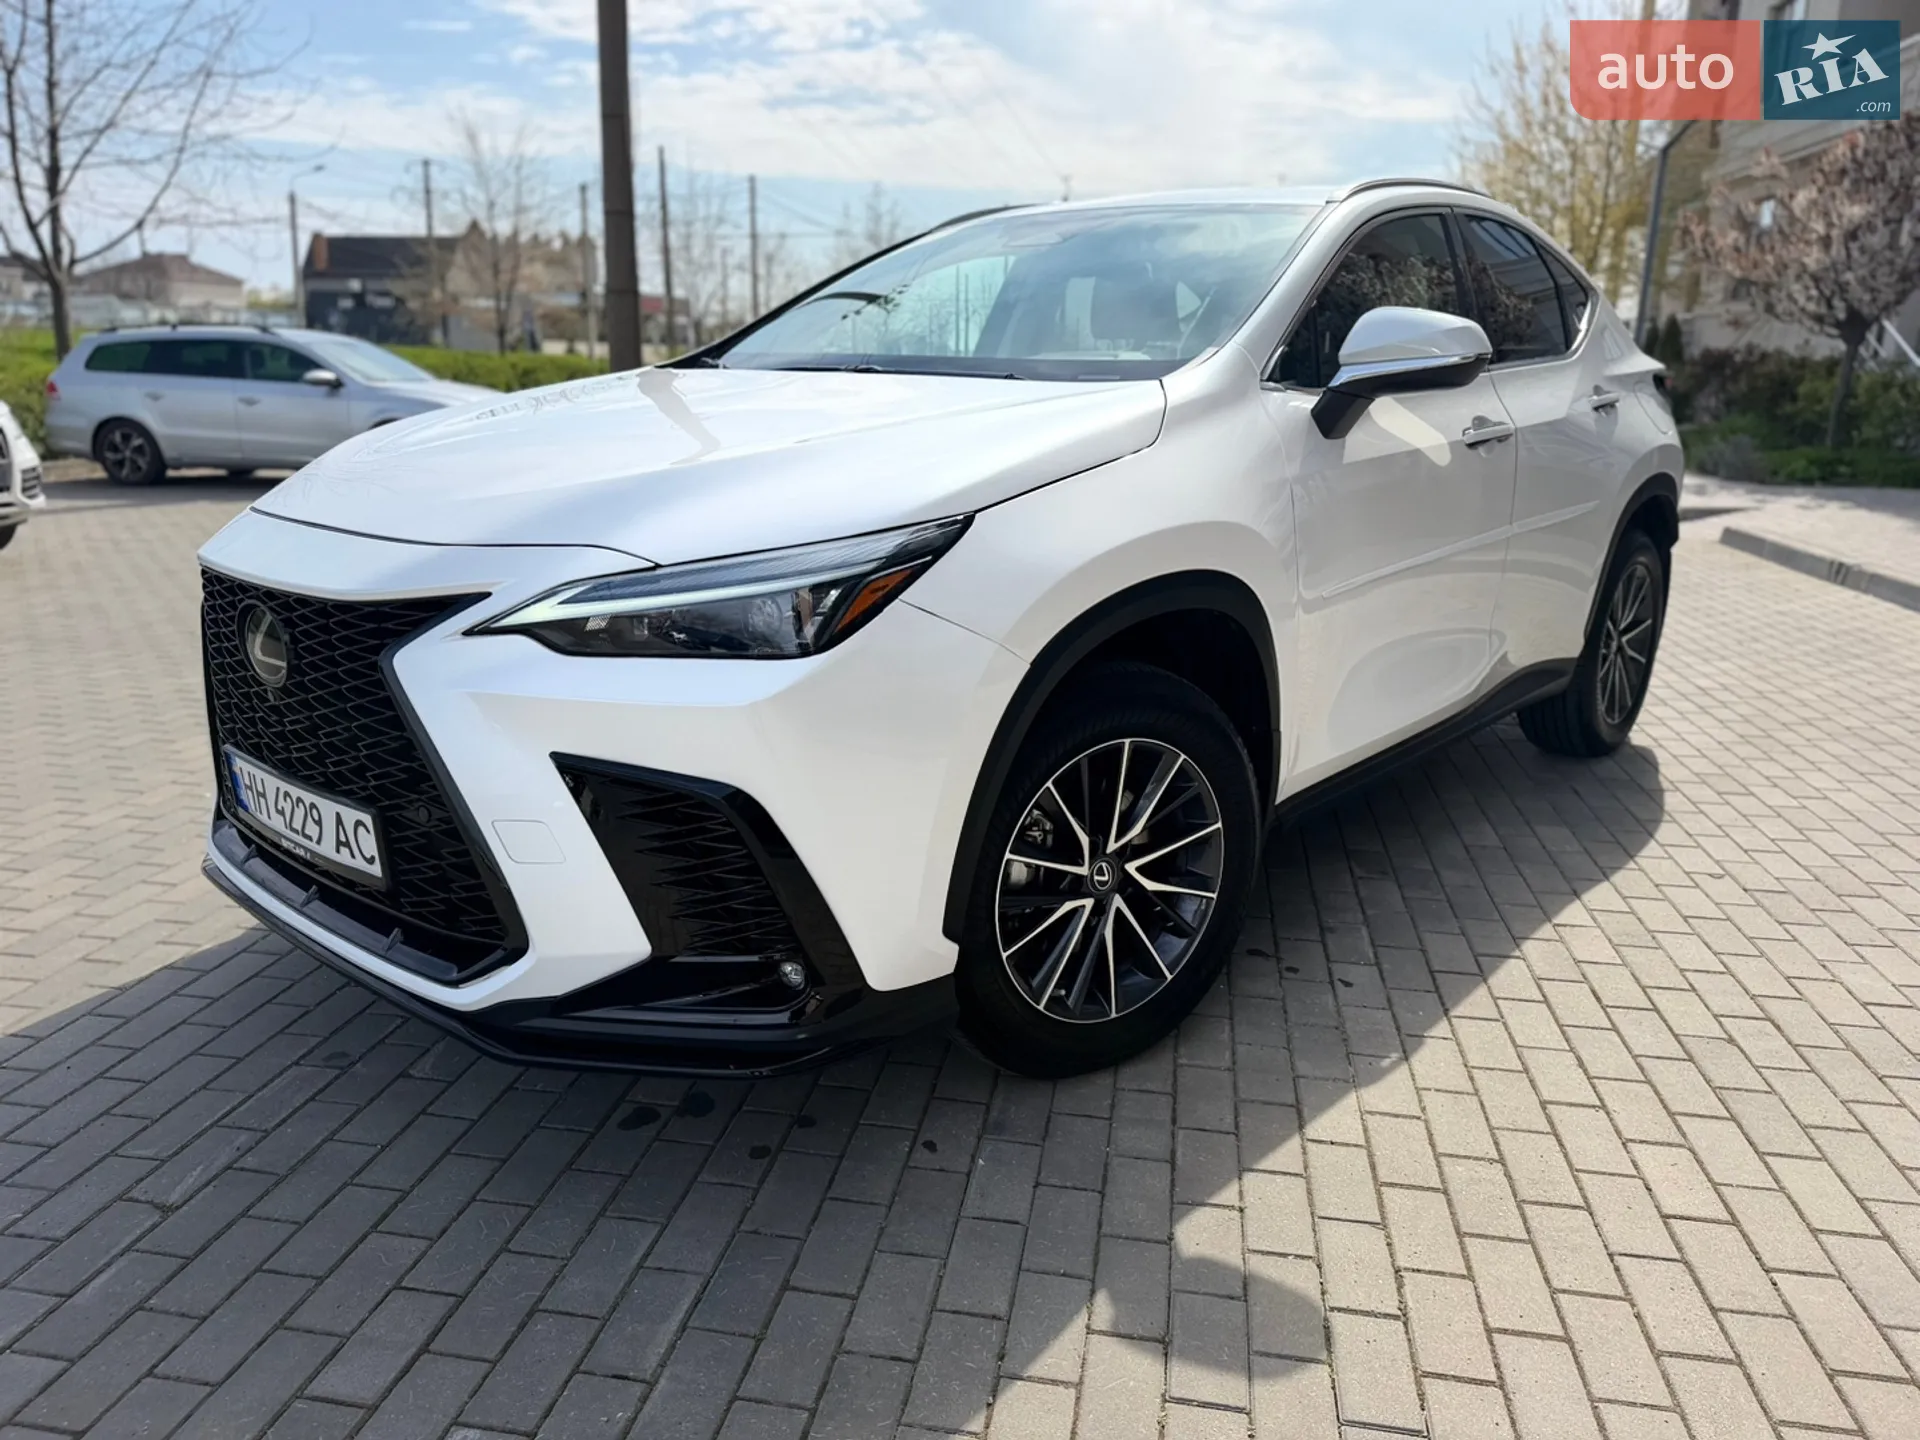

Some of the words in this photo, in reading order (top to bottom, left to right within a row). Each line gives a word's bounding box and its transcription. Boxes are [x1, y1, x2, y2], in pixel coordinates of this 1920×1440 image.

[239, 766, 272, 821] HH
[274, 786, 323, 846] 4229
[334, 811, 376, 866] AC
